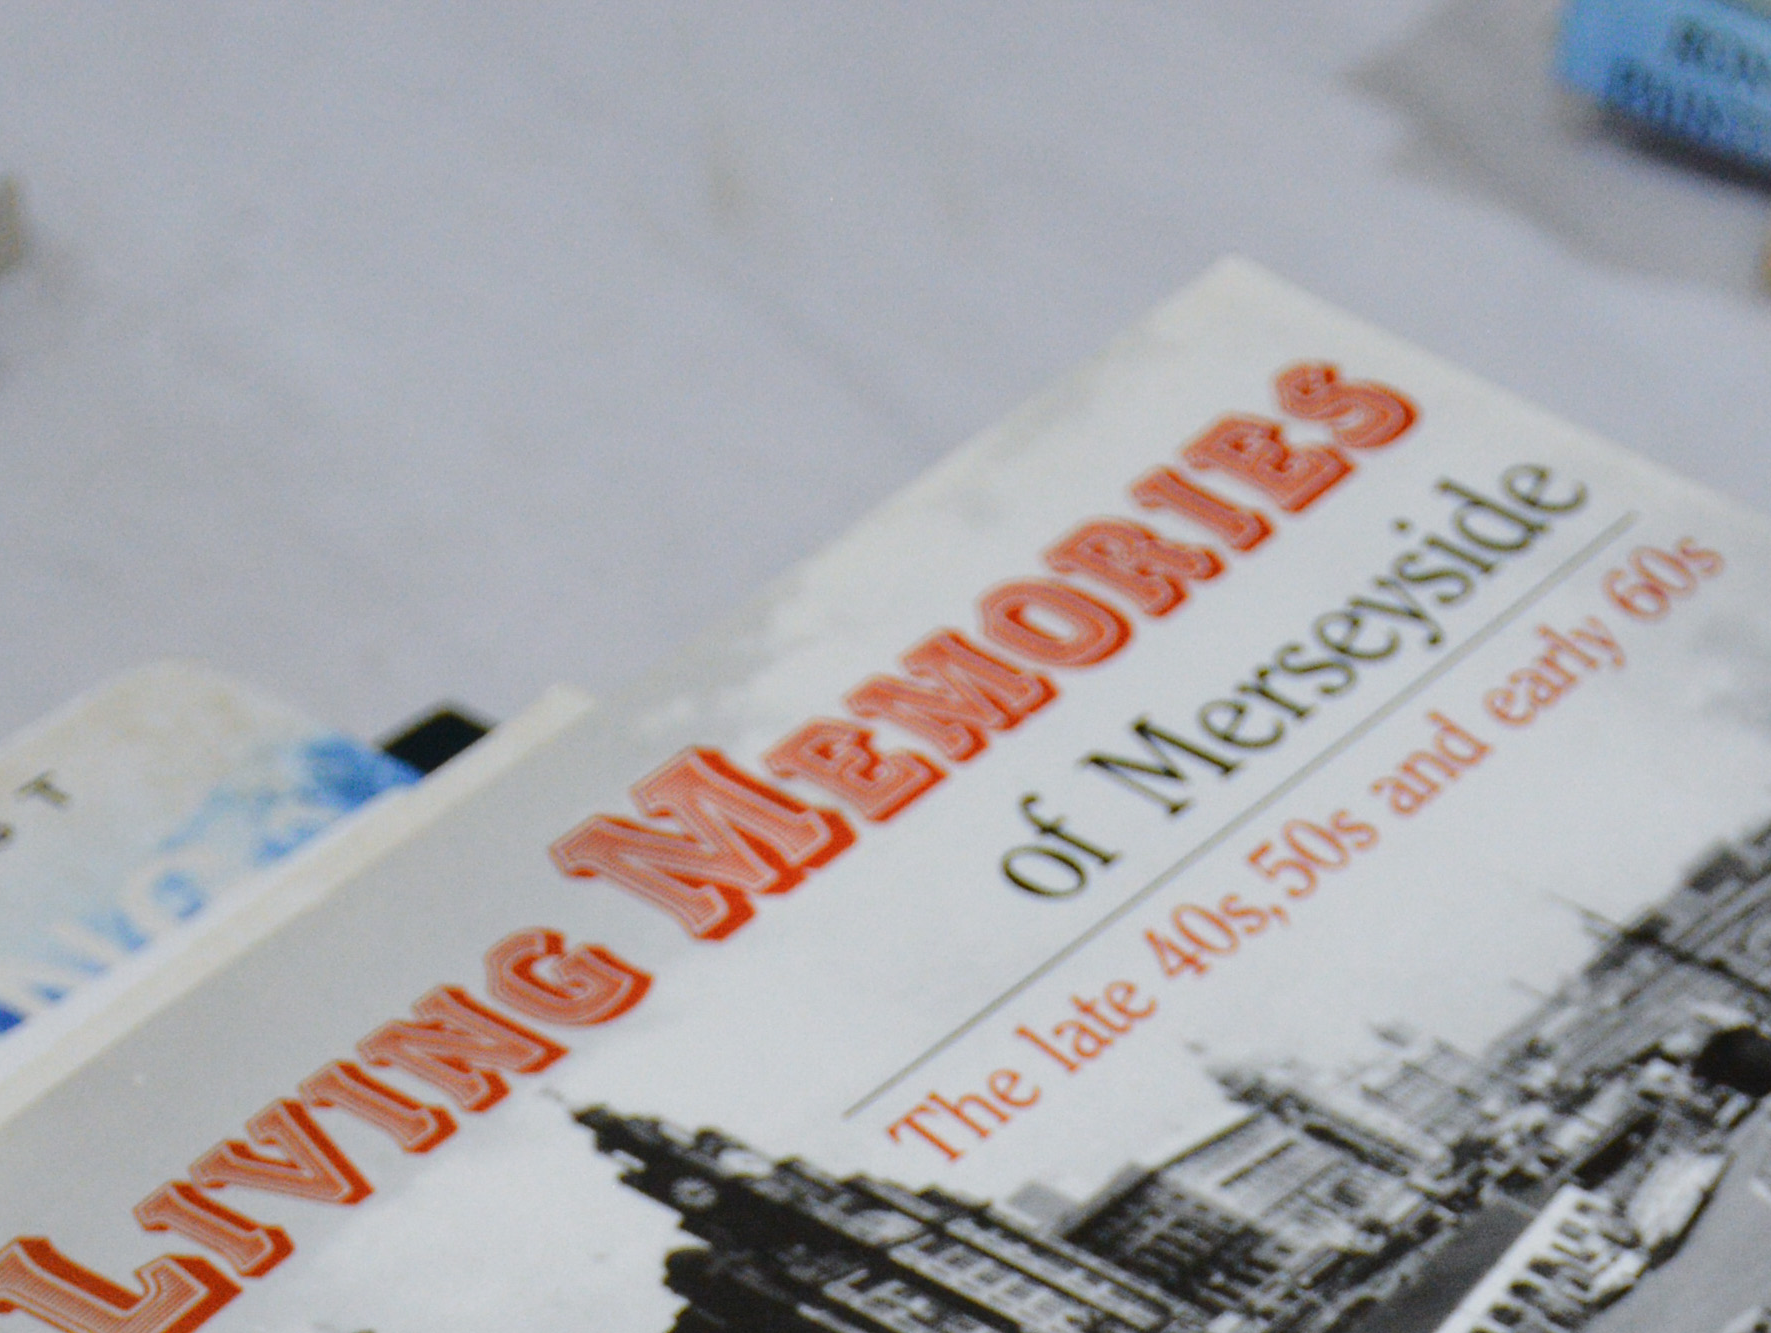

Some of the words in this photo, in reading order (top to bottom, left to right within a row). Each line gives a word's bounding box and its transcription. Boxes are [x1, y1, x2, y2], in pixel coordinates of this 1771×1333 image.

[551, 356, 1427, 943] MEMORIES
[887, 1065, 1043, 1164] The
[1016, 977, 1158, 1075] late
[1370, 711, 1493, 817] and
[1482, 624, 1628, 729] early
[1601, 534, 1726, 624] 60s
[1001, 795, 1127, 901] of
[1081, 462, 1590, 817] Merseyside
